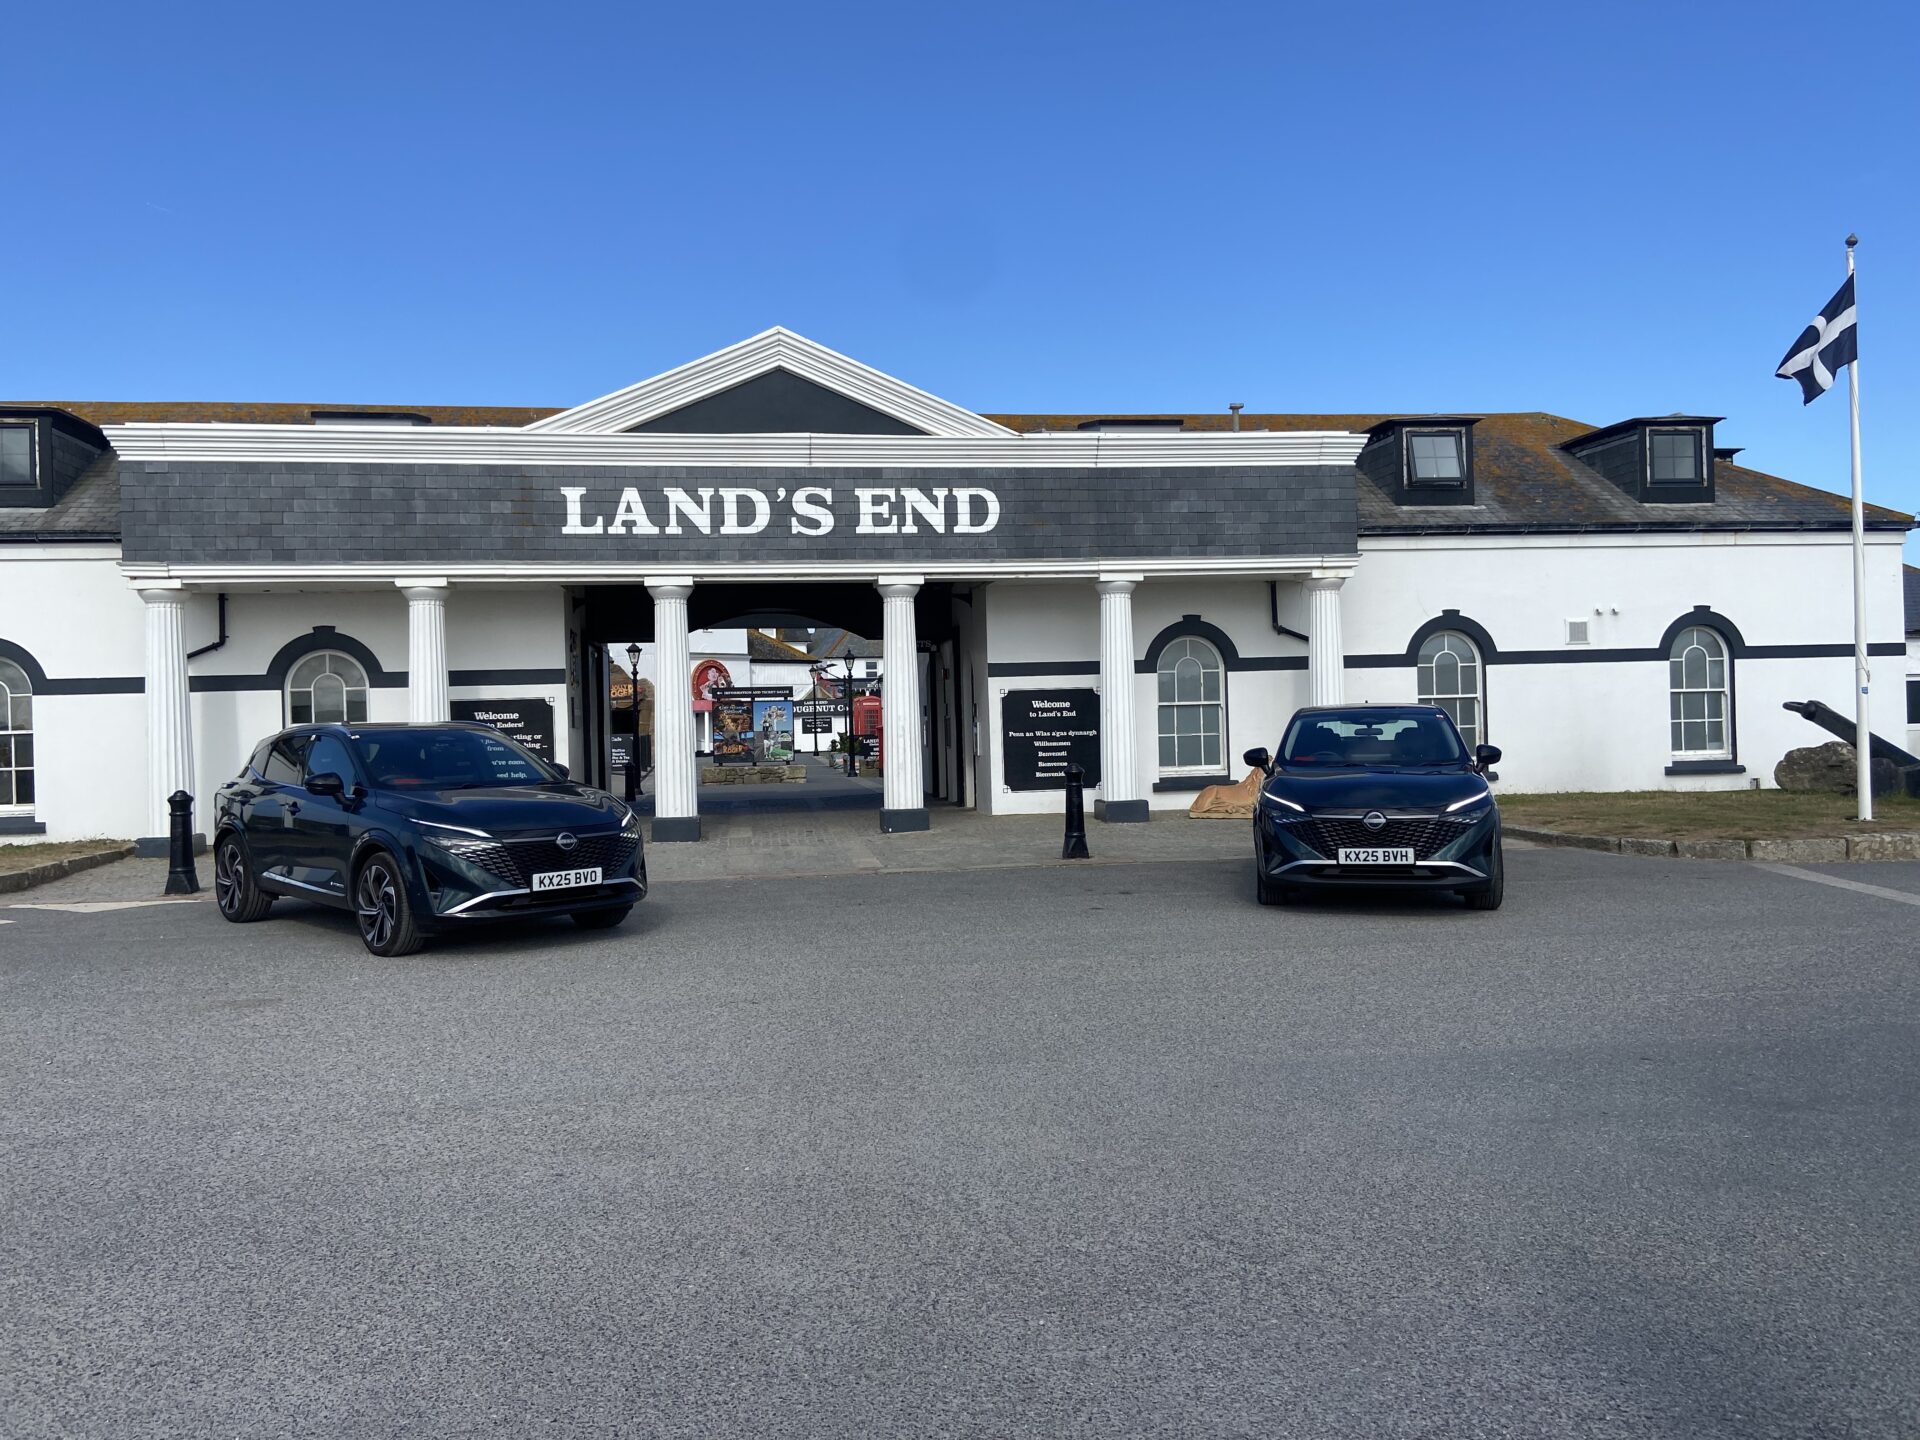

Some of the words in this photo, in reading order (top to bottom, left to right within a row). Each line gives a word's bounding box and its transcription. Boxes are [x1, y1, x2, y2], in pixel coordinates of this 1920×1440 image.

[560, 486, 834, 536] LAND'S
[855, 487, 1001, 534] END
[1032, 700, 1071, 708] Welcome
[474, 712, 519, 720] Welcome
[1344, 850, 1379, 862] KX25
[1382, 850, 1408, 862] BVH
[538, 873, 571, 888] KX25
[574, 870, 597, 884] BVO
